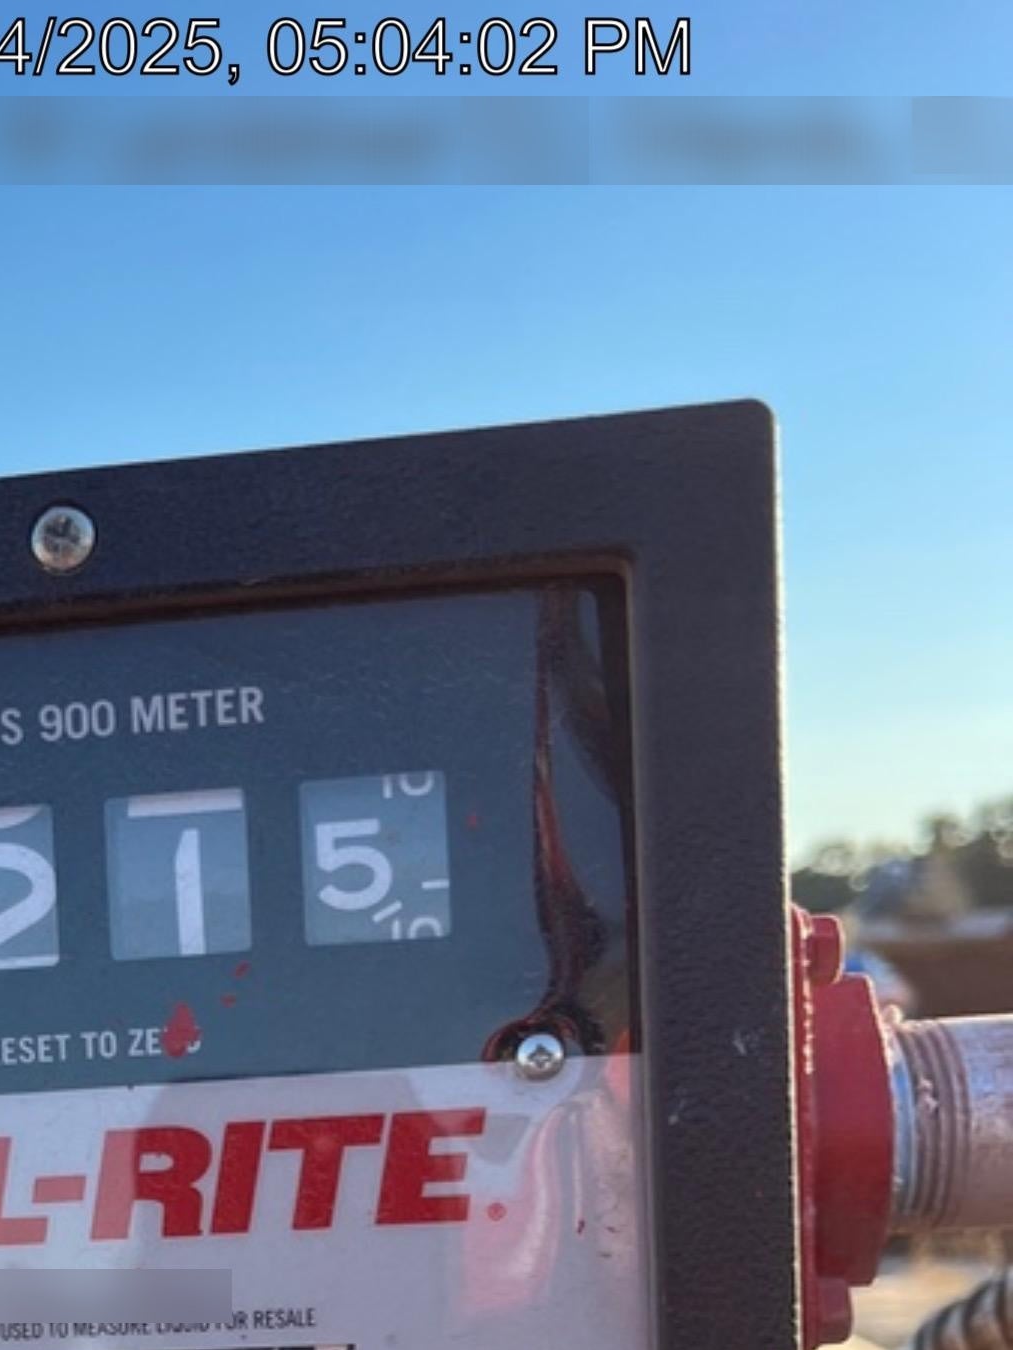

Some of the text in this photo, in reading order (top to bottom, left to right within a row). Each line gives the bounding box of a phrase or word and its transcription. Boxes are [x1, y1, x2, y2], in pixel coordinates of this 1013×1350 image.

[39, 699, 115, 744] 900
[129, 686, 266, 733] METER
[80, 1031, 117, 1060] TO
[128, 1027, 201, 1057] ZE
[253, 1308, 317, 1331] RESALE
